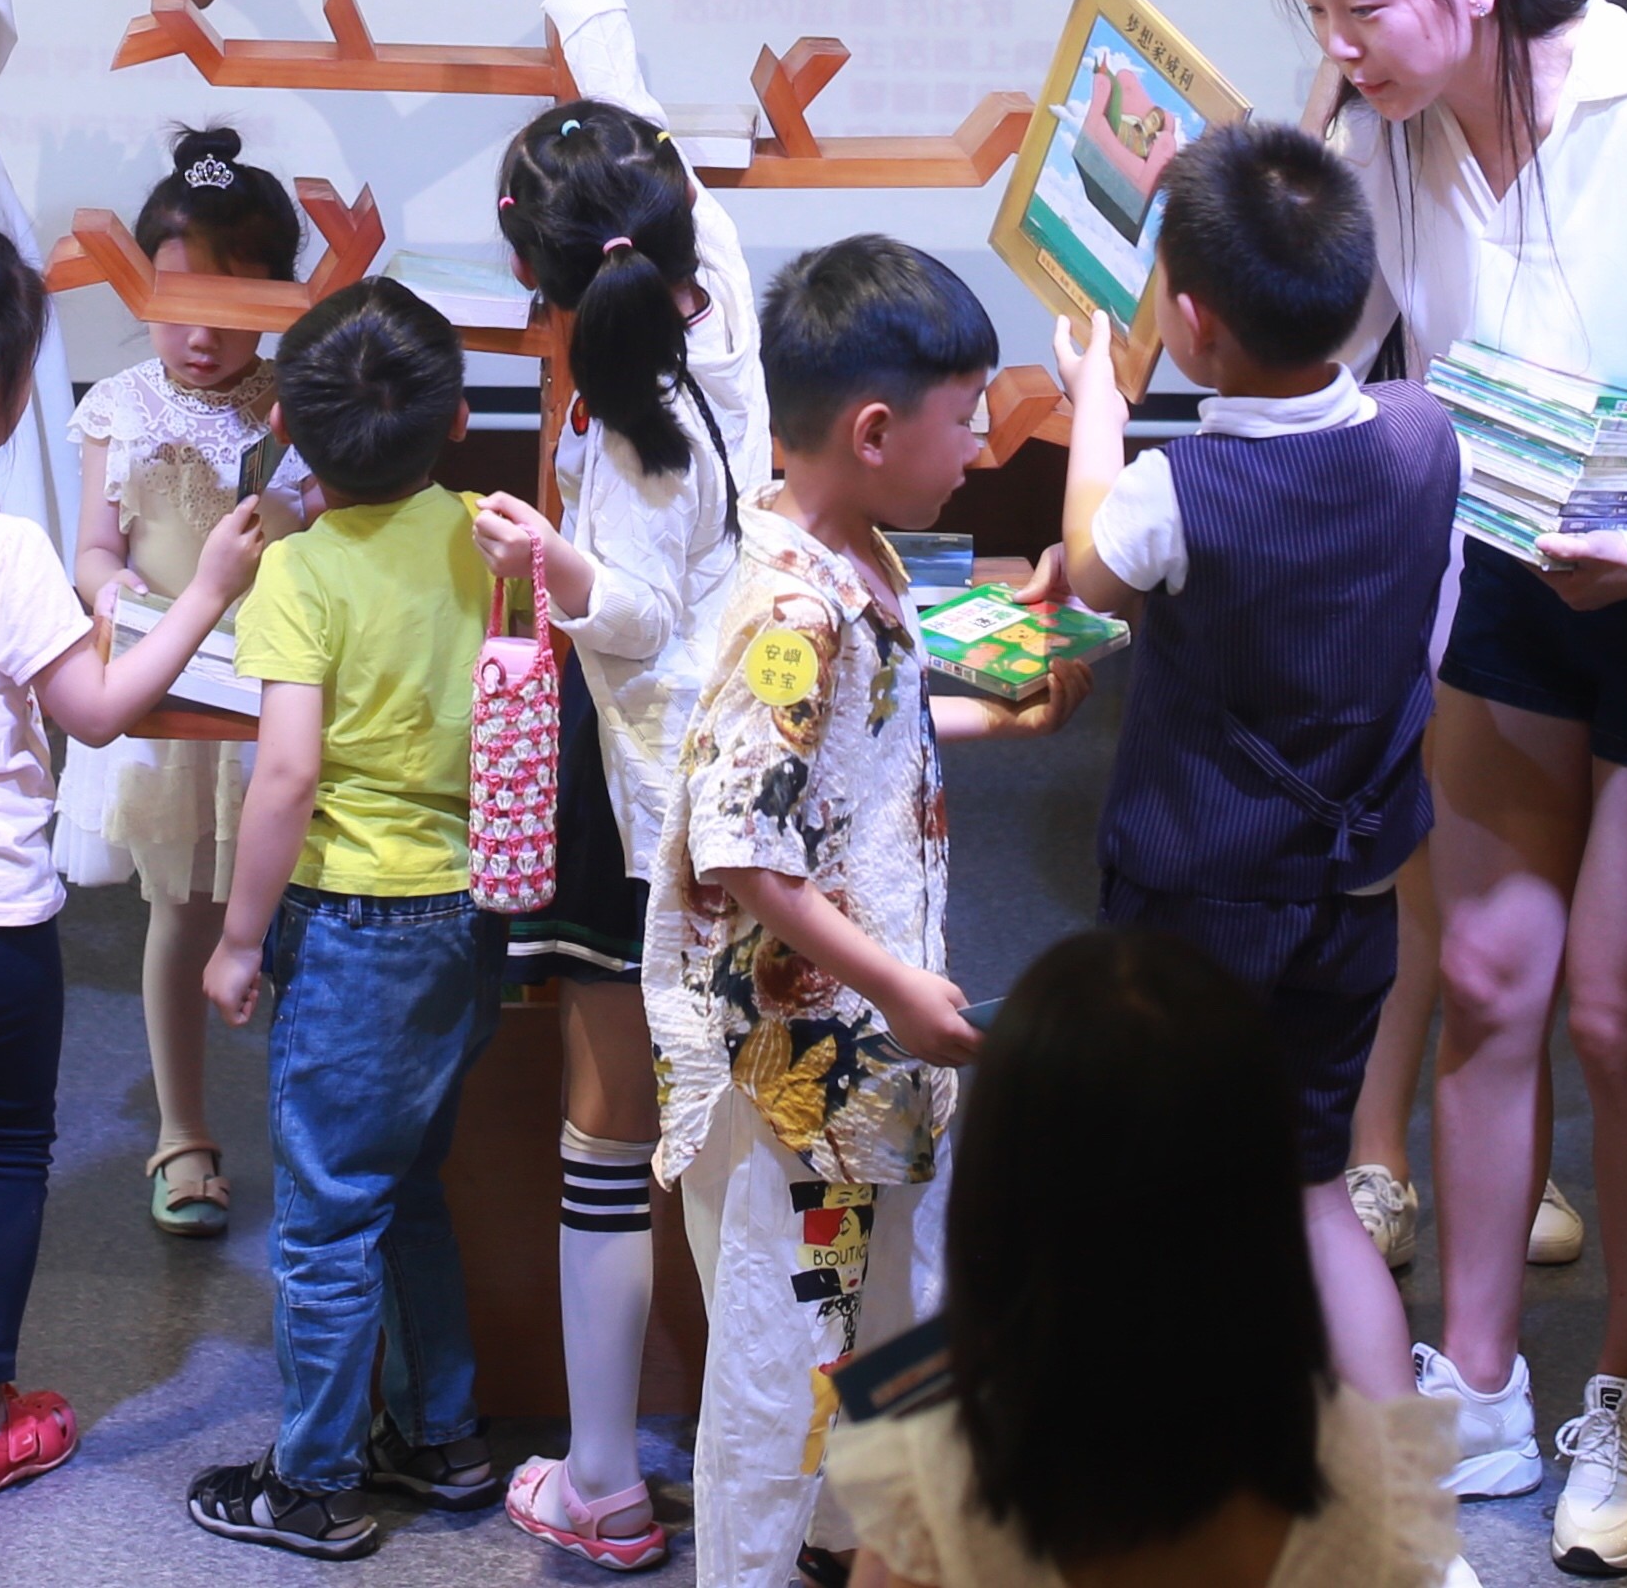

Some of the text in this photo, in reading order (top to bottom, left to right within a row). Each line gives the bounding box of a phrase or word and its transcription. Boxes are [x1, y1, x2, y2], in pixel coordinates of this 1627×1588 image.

[1124, 13, 1195, 92] 梦想家威利
[759, 667, 797, 691] 宝宝
